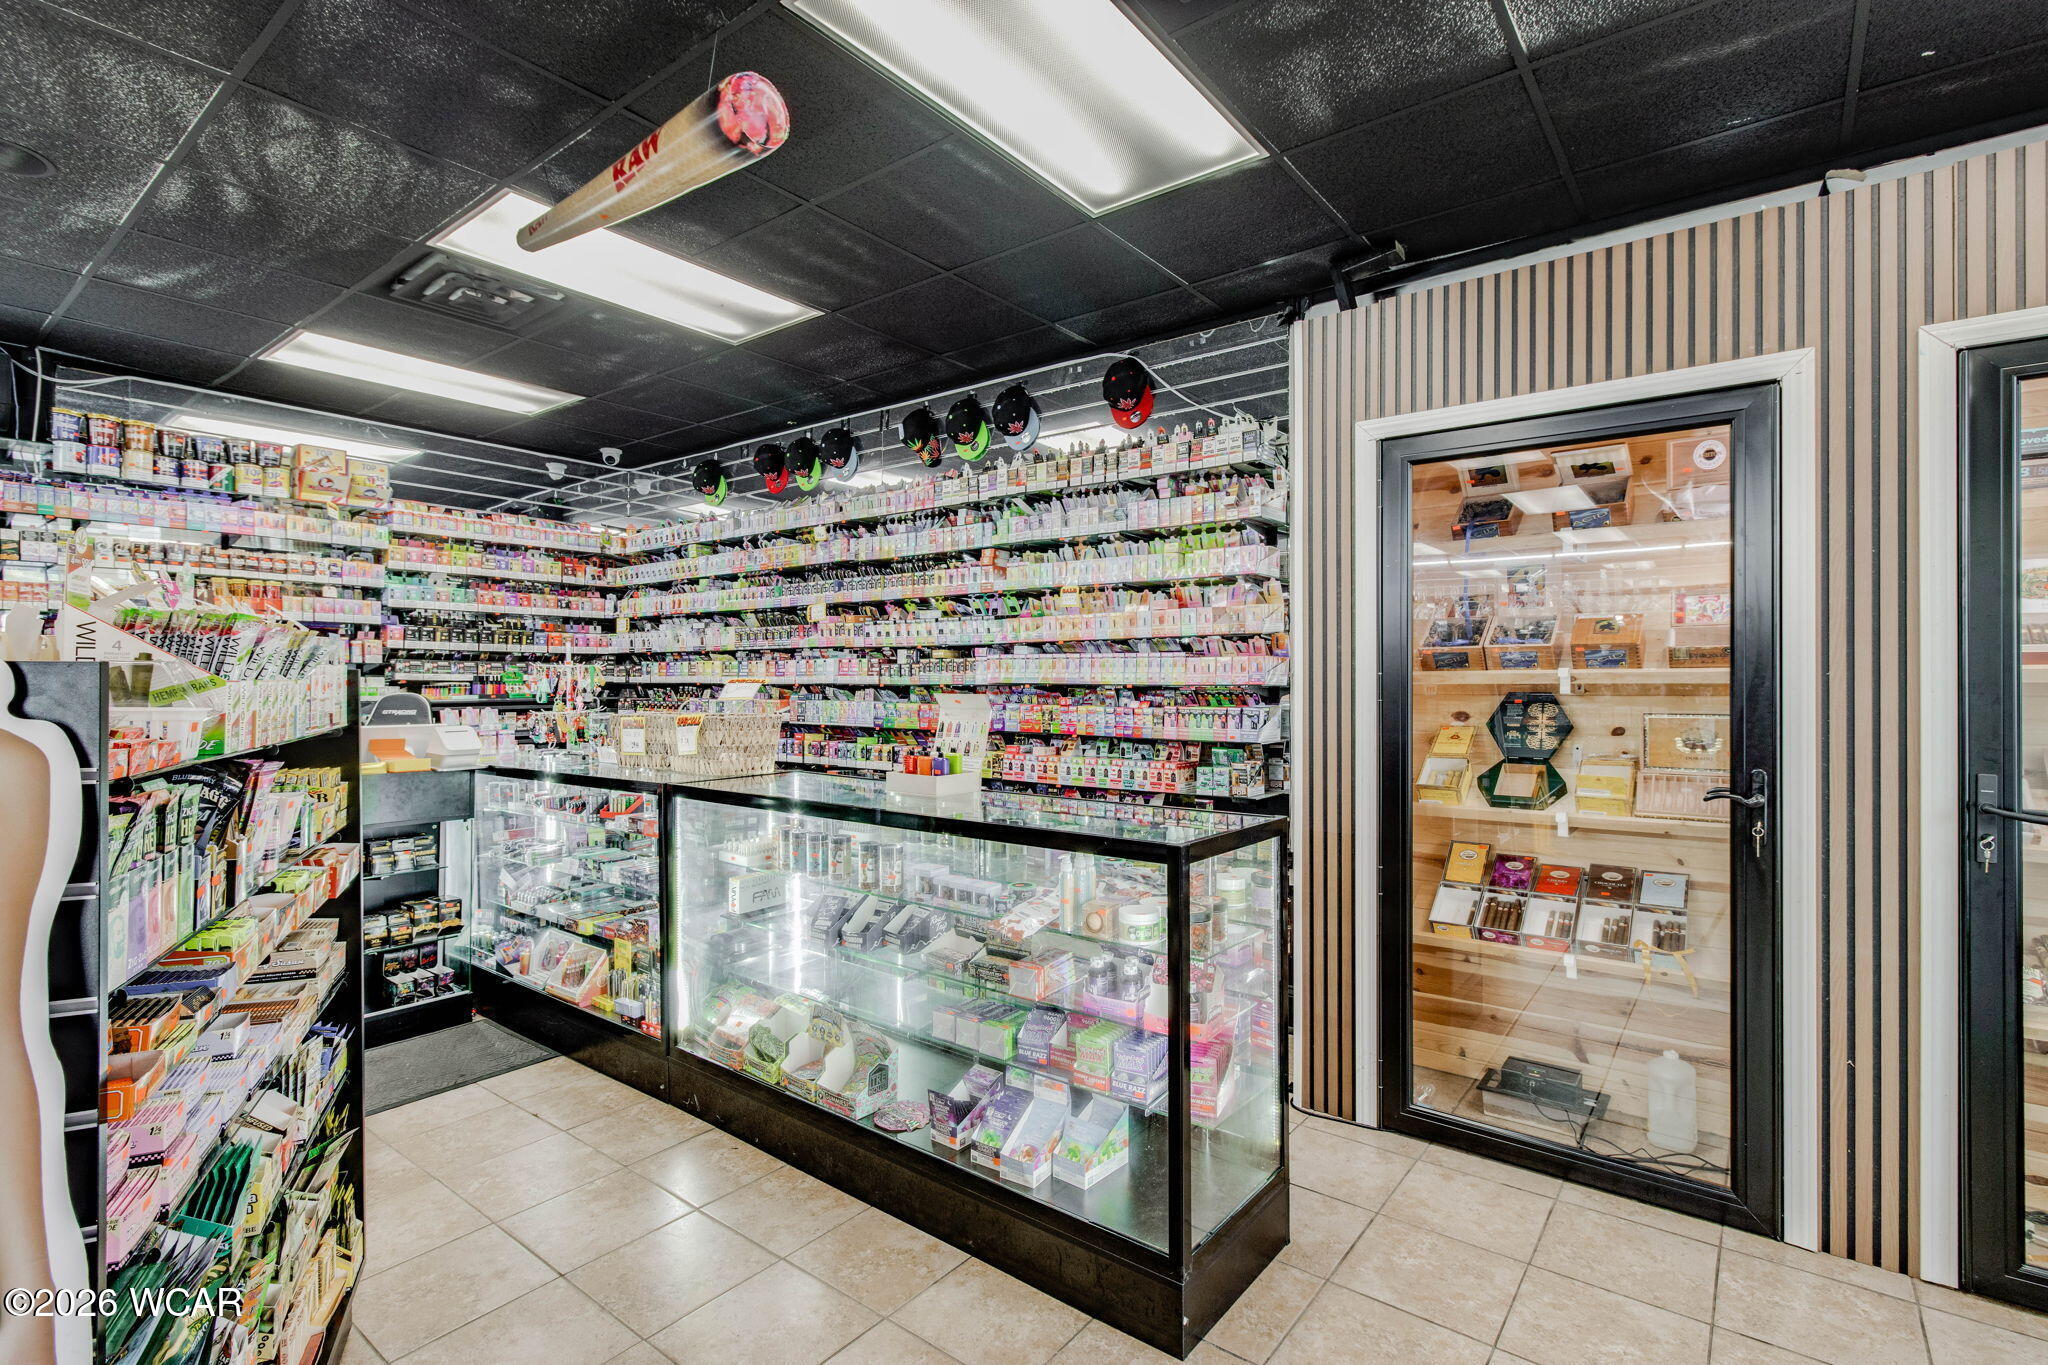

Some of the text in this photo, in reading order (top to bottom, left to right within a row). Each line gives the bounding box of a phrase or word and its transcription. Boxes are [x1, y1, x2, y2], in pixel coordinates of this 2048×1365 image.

[1573, 512, 1608, 526] ACID
[1437, 656, 1465, 668] ACID
[1502, 653, 1536, 668] ACID
[1588, 652, 1625, 666] ACID
[152, 689, 179, 703] HEMP
[271, 958, 306, 968] Susan
